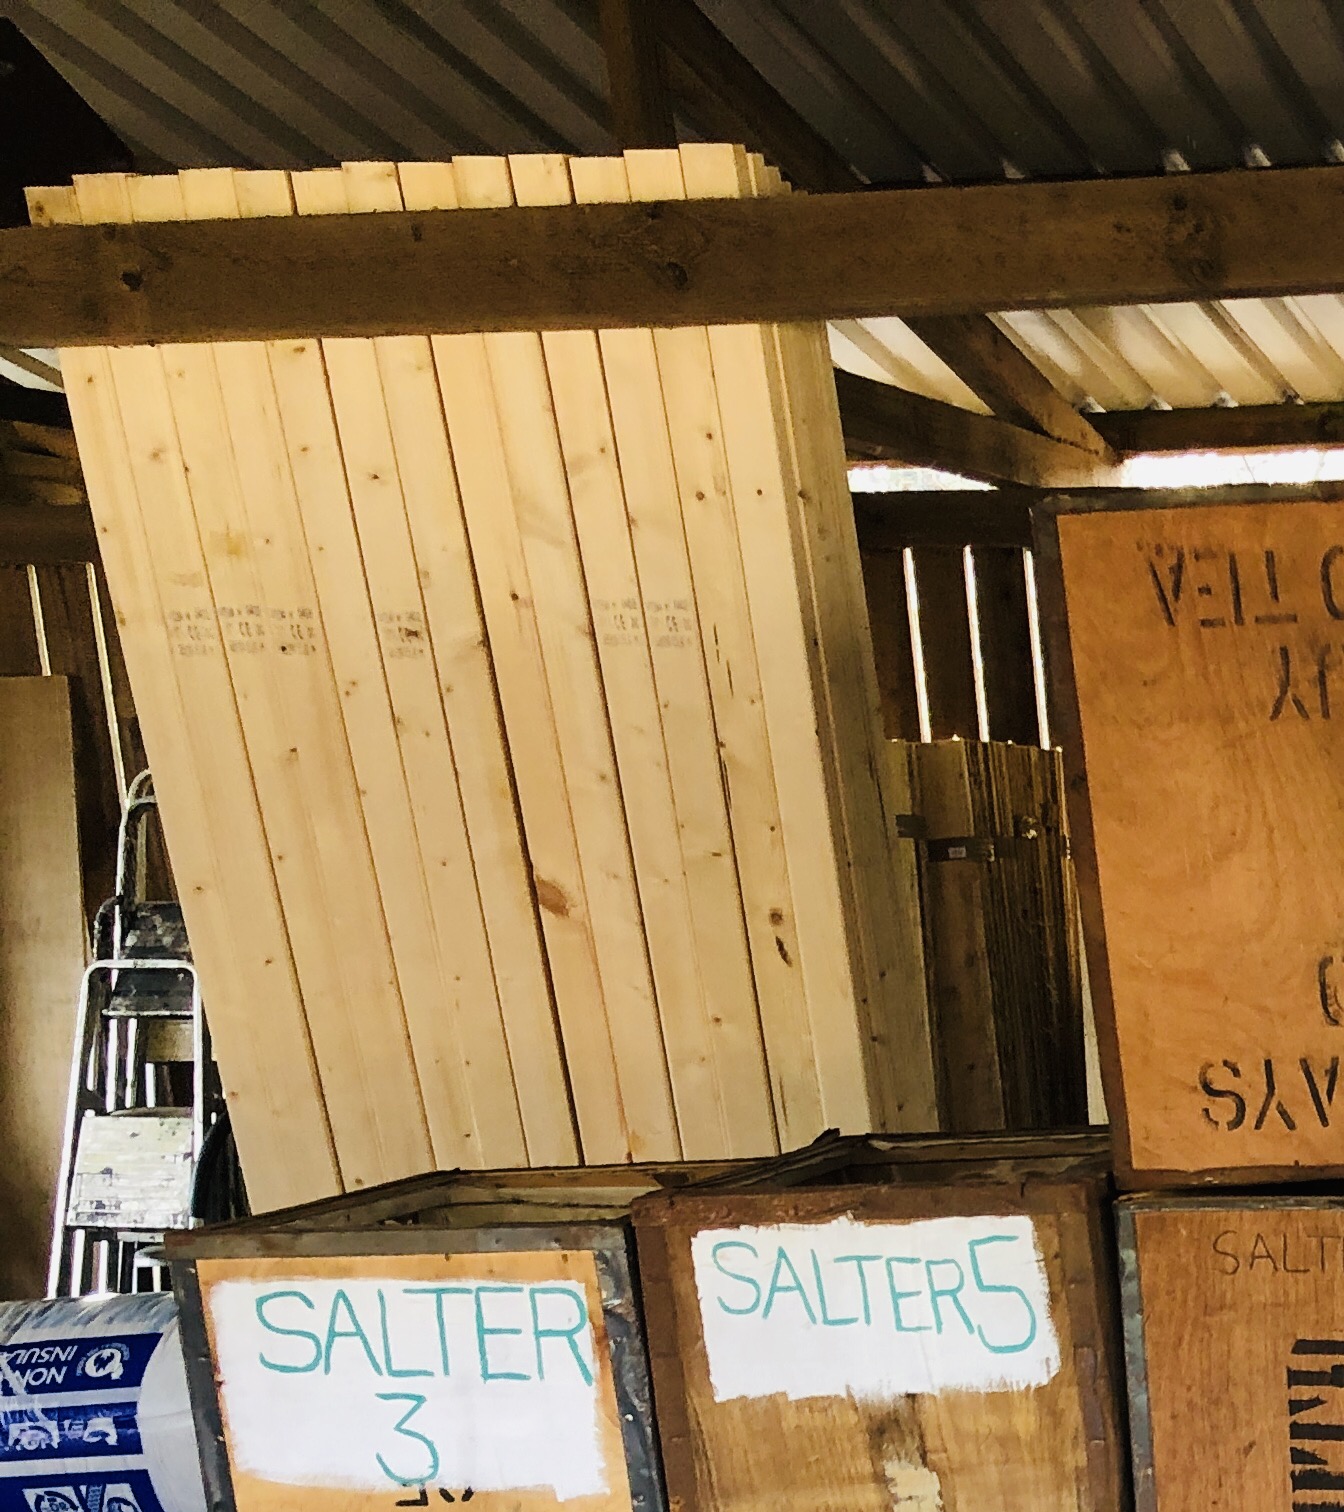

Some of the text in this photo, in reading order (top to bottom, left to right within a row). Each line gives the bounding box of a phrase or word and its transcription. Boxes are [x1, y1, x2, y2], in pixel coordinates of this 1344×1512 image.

[1138, 538, 1299, 629] TEA
[255, 1285, 595, 1387] SALTER
[711, 1234, 1038, 1355] SALTER 5
[374, 1391, 441, 1487] 3
